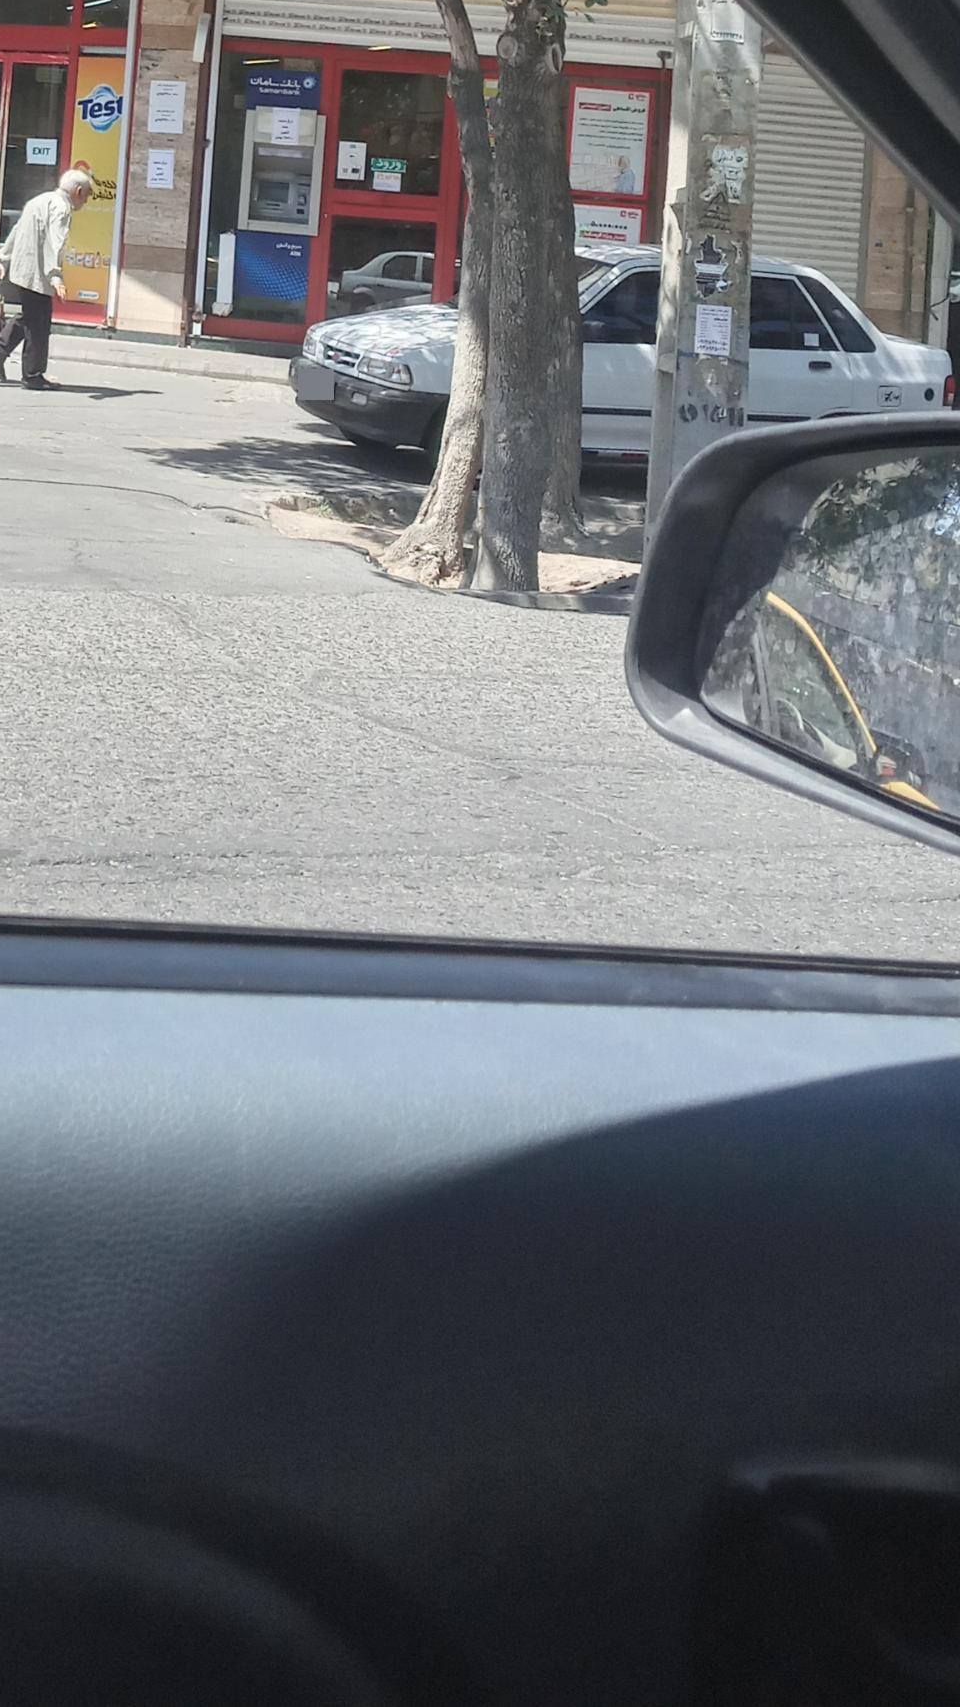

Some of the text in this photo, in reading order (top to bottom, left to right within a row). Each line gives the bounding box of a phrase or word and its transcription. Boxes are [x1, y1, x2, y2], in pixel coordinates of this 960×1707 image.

[250, 77, 301, 90] بانک سامان
[78, 96, 123, 120] Test
[32, 146, 51, 155] EXIT
[376, 159, 402, 170] ورود
